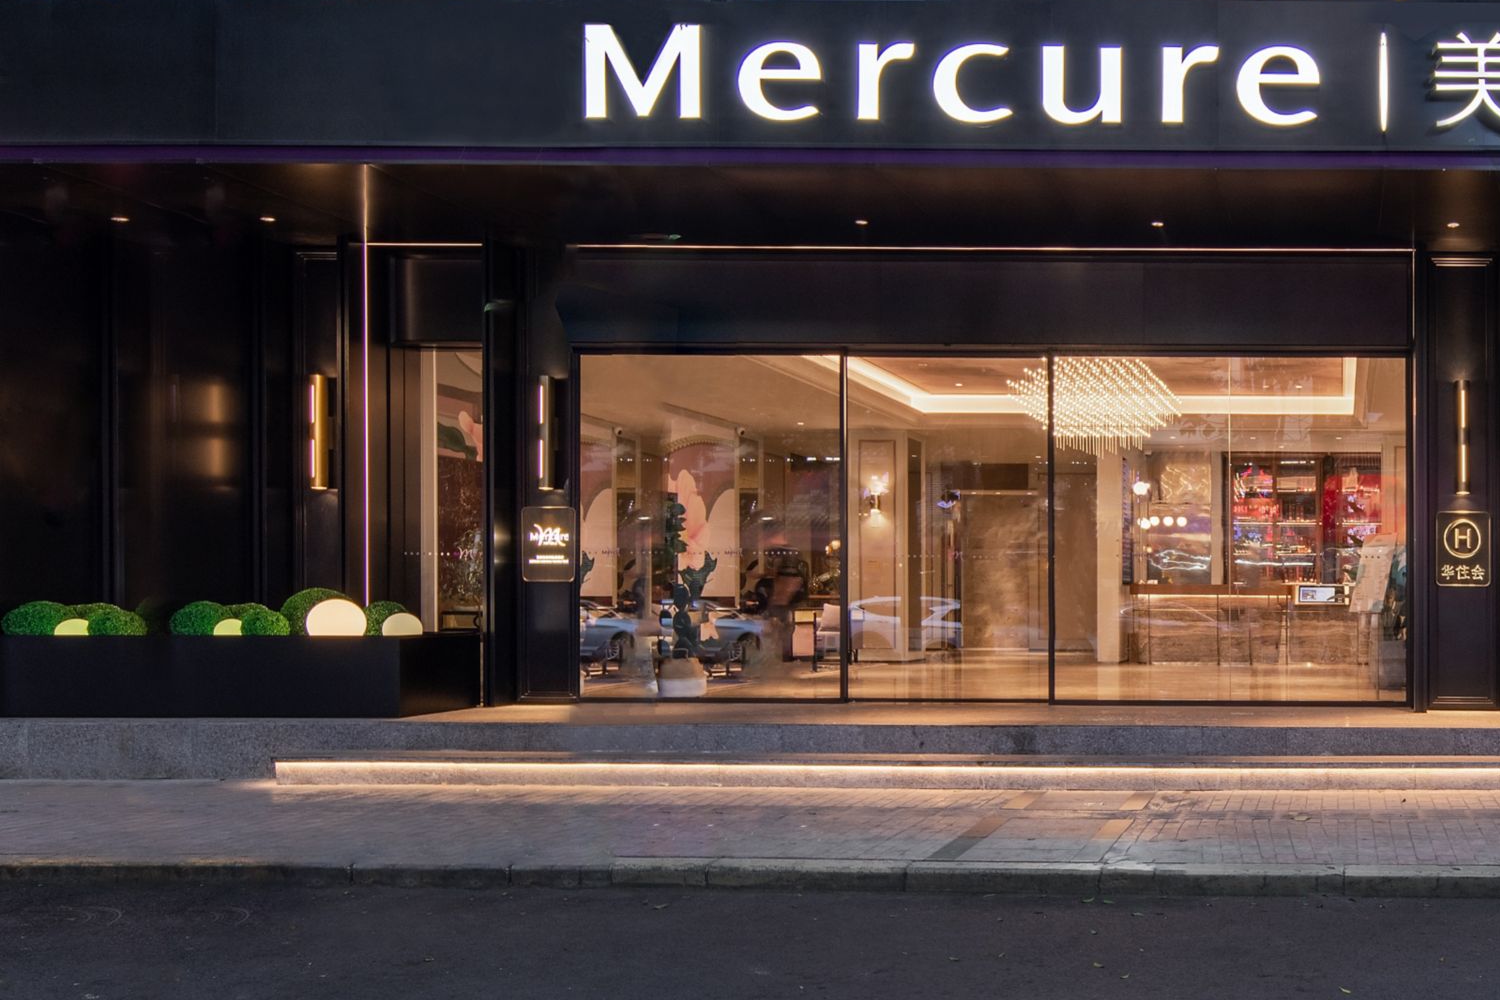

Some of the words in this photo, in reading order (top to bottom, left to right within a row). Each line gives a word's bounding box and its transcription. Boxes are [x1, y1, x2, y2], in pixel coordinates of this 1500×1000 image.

[583, 23, 1321, 126] Mercure
[1441, 564, 1485, 581] 华住会
